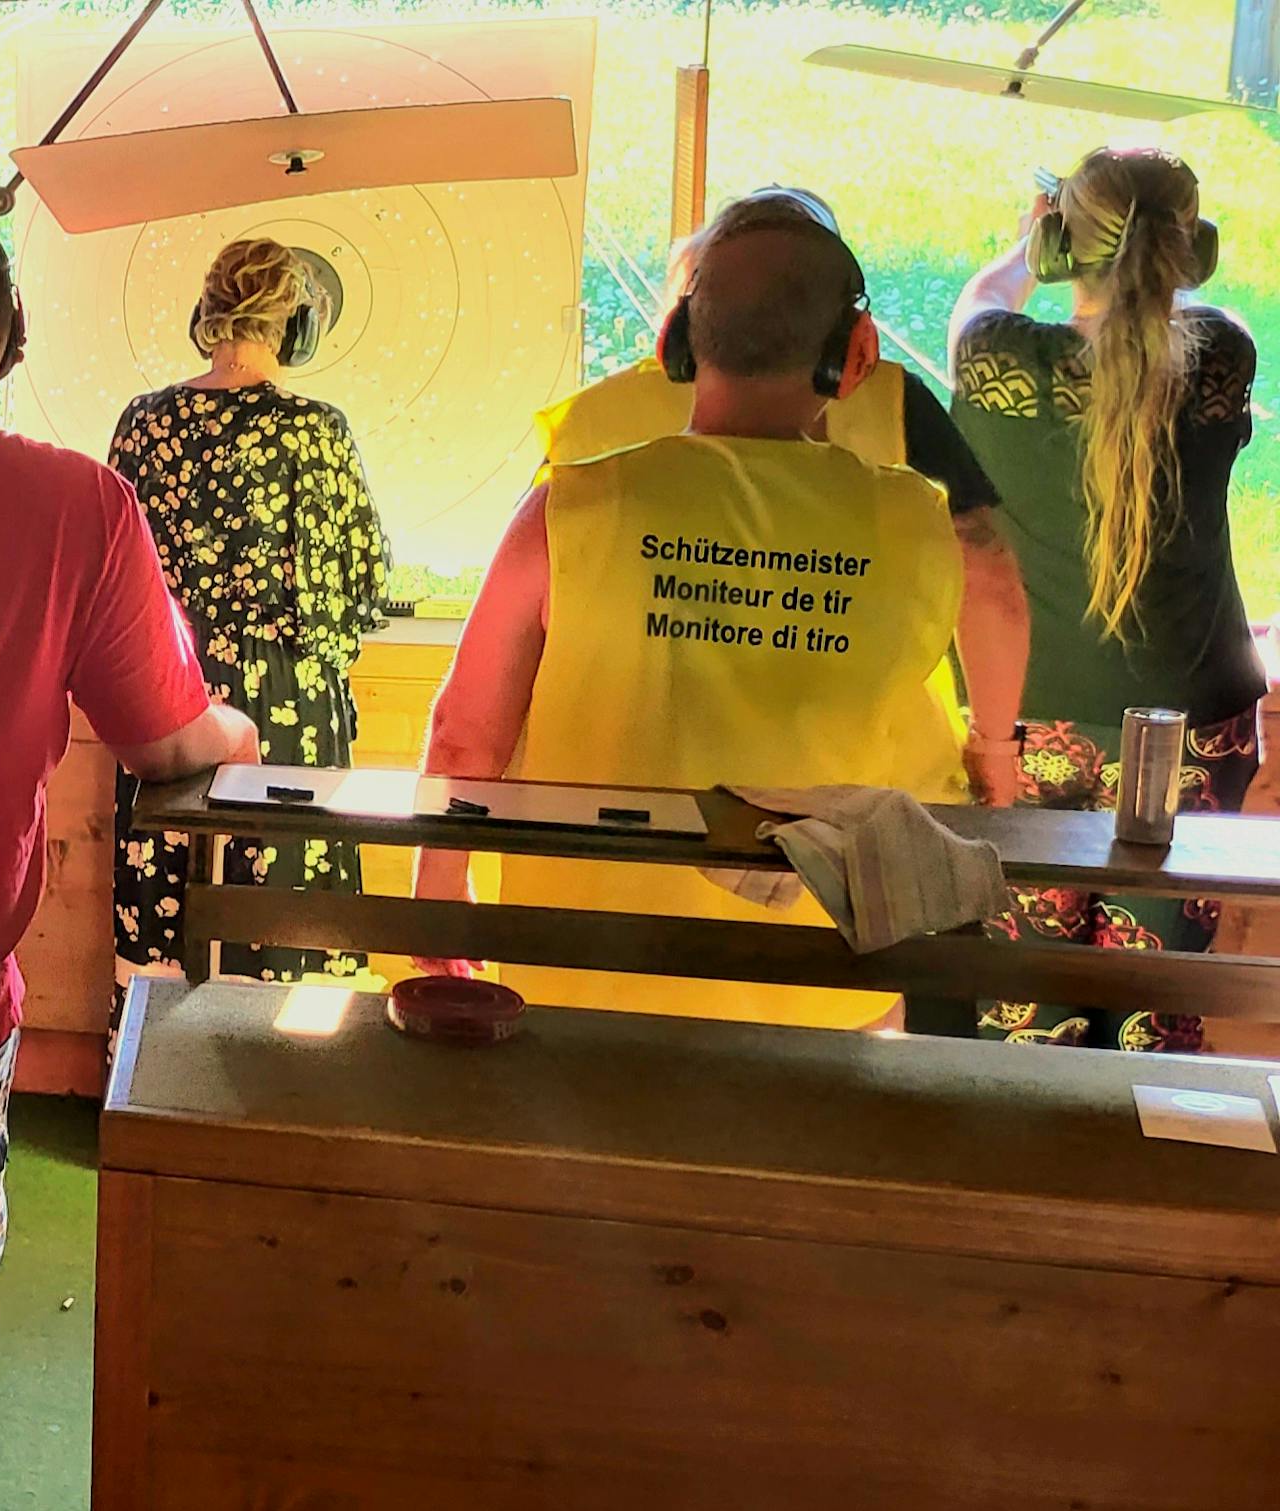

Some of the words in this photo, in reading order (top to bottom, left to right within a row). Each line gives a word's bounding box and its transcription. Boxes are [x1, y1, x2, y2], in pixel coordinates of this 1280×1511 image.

[640, 534, 871, 577] Schützenmeister
[653, 574, 774, 608] Moniteur
[781, 586, 815, 612] de
[823, 590, 853, 615] tir
[646, 612, 763, 646] Monitore
[772, 625, 798, 650] di
[806, 628, 850, 654] tiro
